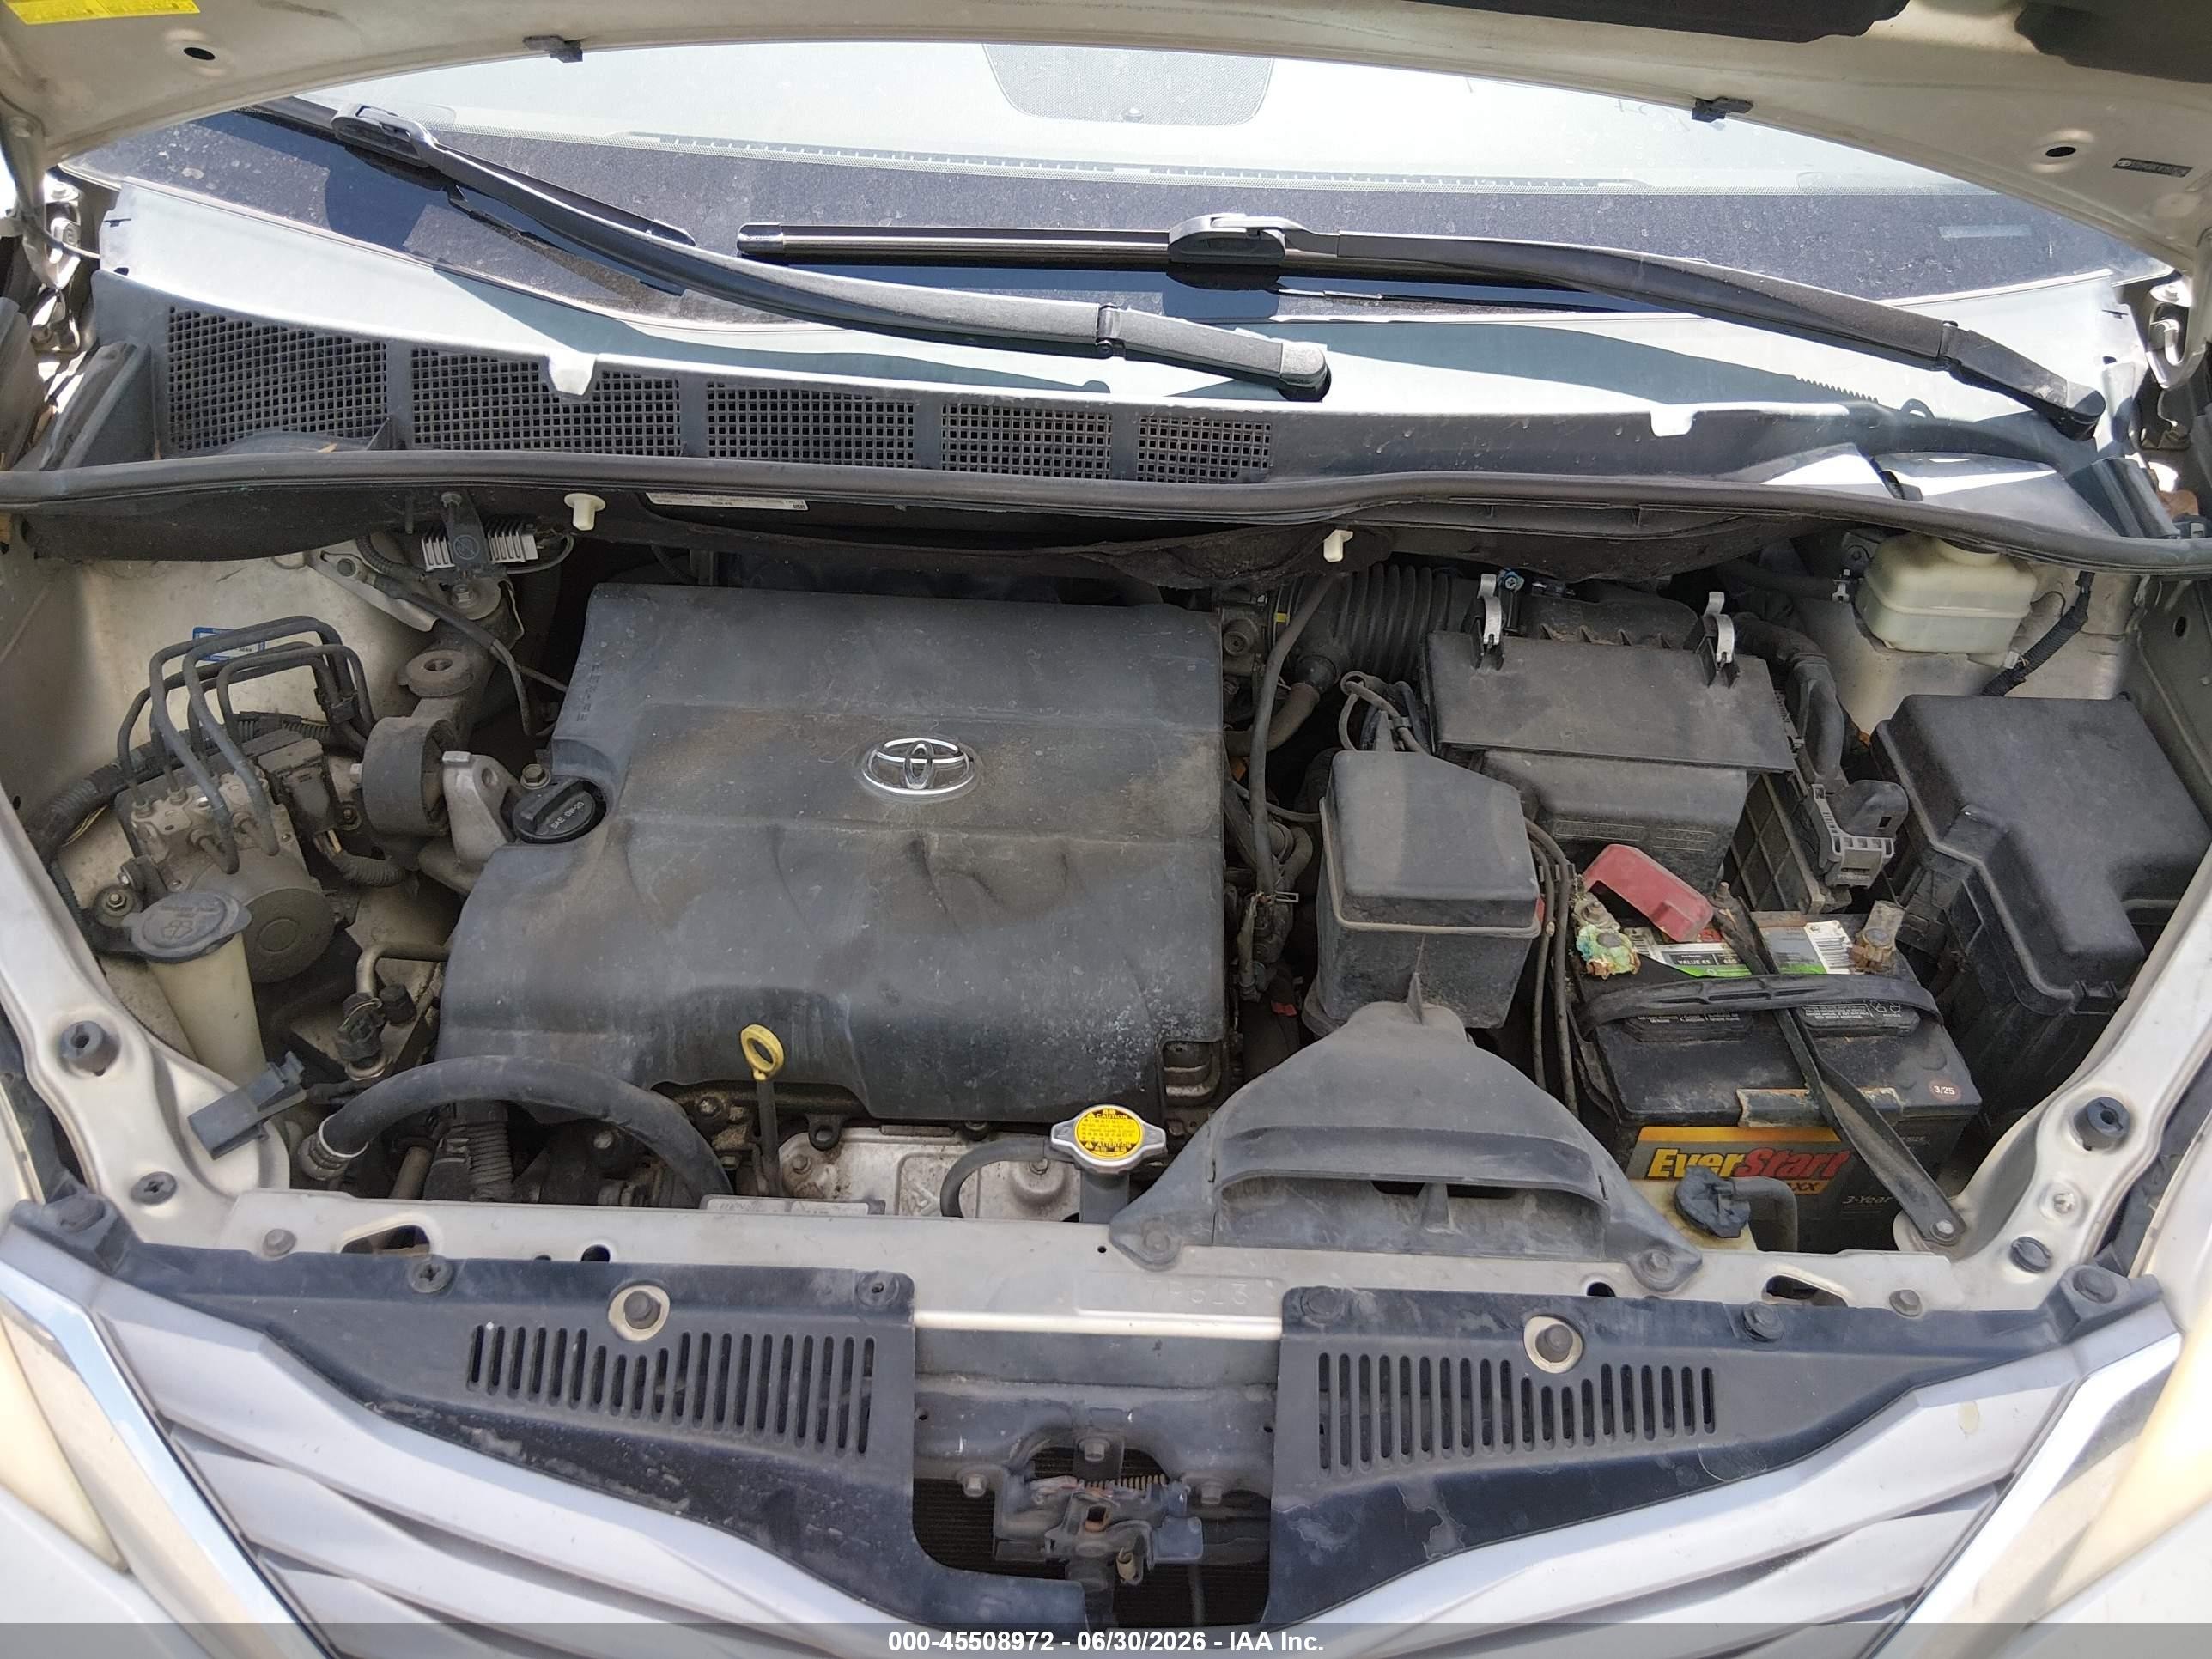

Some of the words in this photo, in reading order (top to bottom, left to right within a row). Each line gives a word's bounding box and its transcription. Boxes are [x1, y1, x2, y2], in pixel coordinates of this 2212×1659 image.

[550, 817, 565, 830] SAE
[1933, 1085, 1956, 1095] 3/25
[1646, 1146, 1852, 1181] EverStart
[1841, 1194, 1894, 1205] 3-Year
